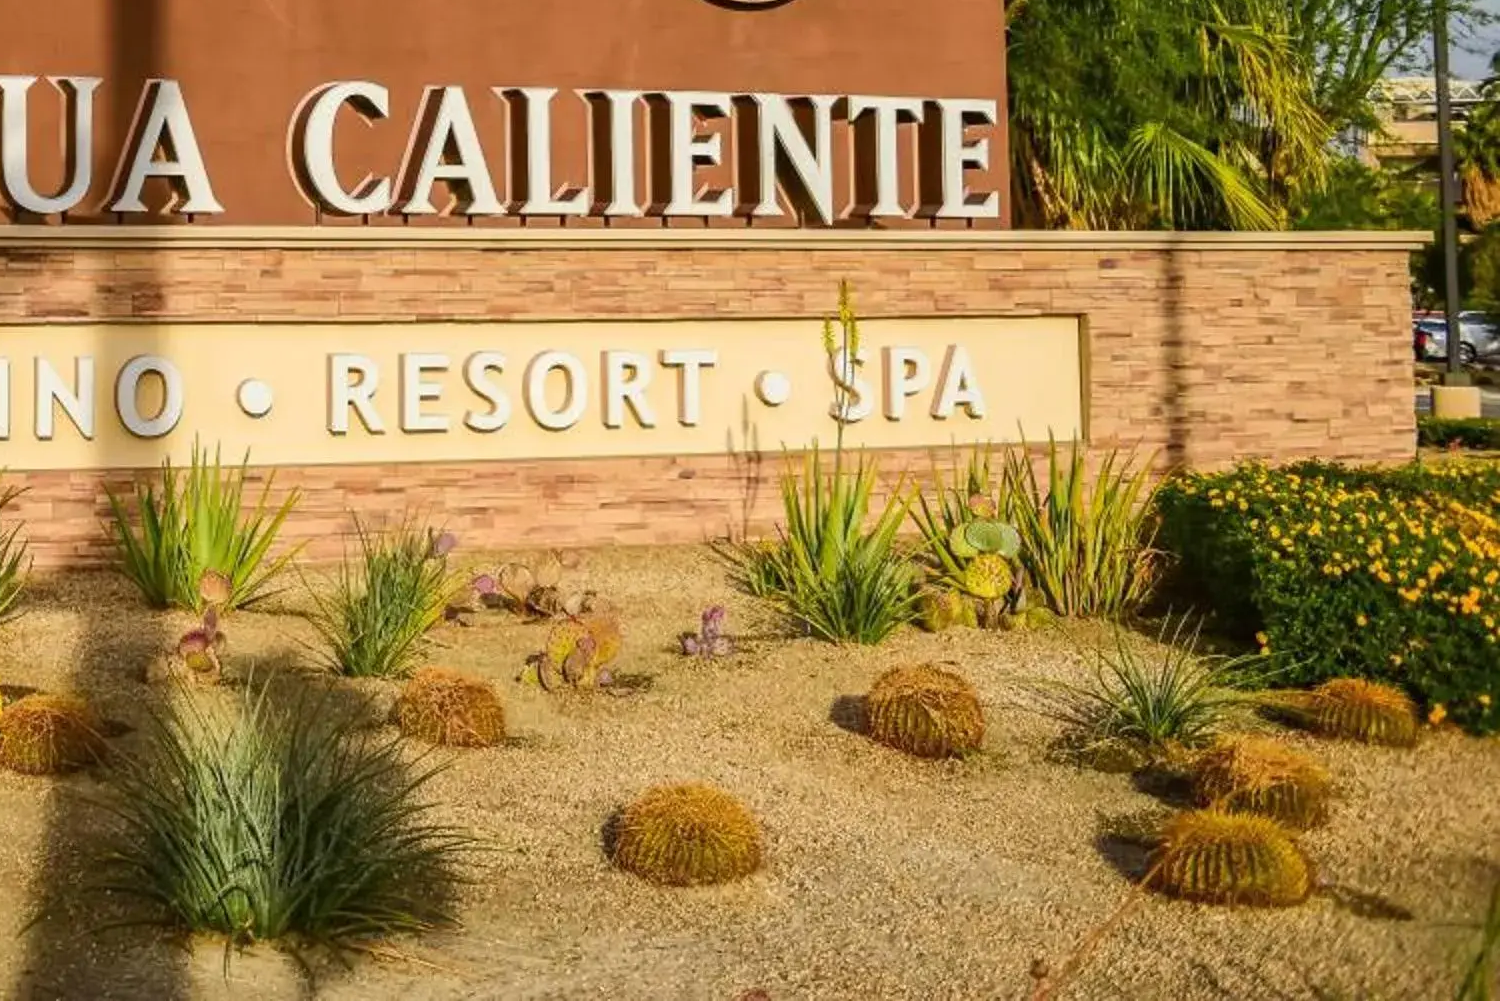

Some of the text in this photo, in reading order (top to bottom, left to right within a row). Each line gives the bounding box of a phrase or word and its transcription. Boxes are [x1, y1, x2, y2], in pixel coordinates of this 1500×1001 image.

[286, 80, 1000, 225] CALIENTE
[325, 349, 718, 434] RESORT
[827, 343, 988, 424] SPA
